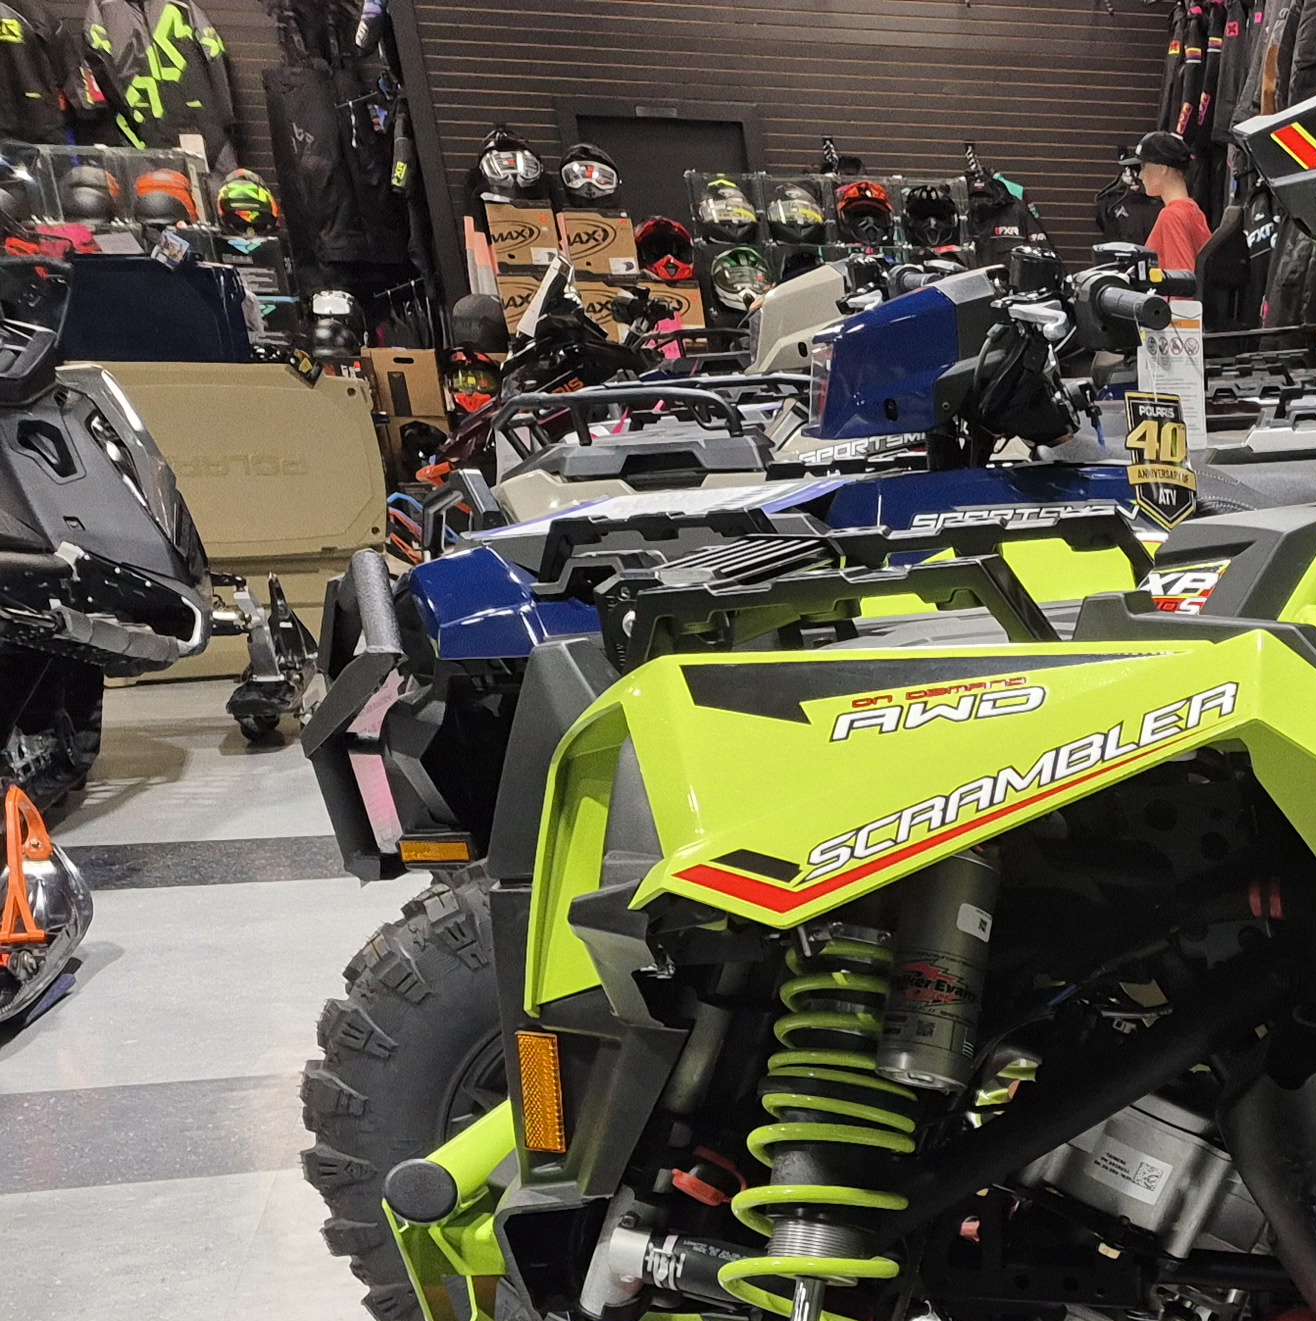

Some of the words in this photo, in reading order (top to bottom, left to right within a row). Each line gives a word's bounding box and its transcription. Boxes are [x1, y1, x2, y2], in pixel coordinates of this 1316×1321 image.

[1138, 404, 1176, 419] POLARIS
[798, 432, 927, 467] SPORTSM
[1158, 487, 1178, 506] ATV
[1140, 572, 1220, 596] XP
[907, 676, 1027, 702] DEMAND
[829, 685, 1049, 743] AWD
[806, 680, 1241, 883] SCRAMBLER
